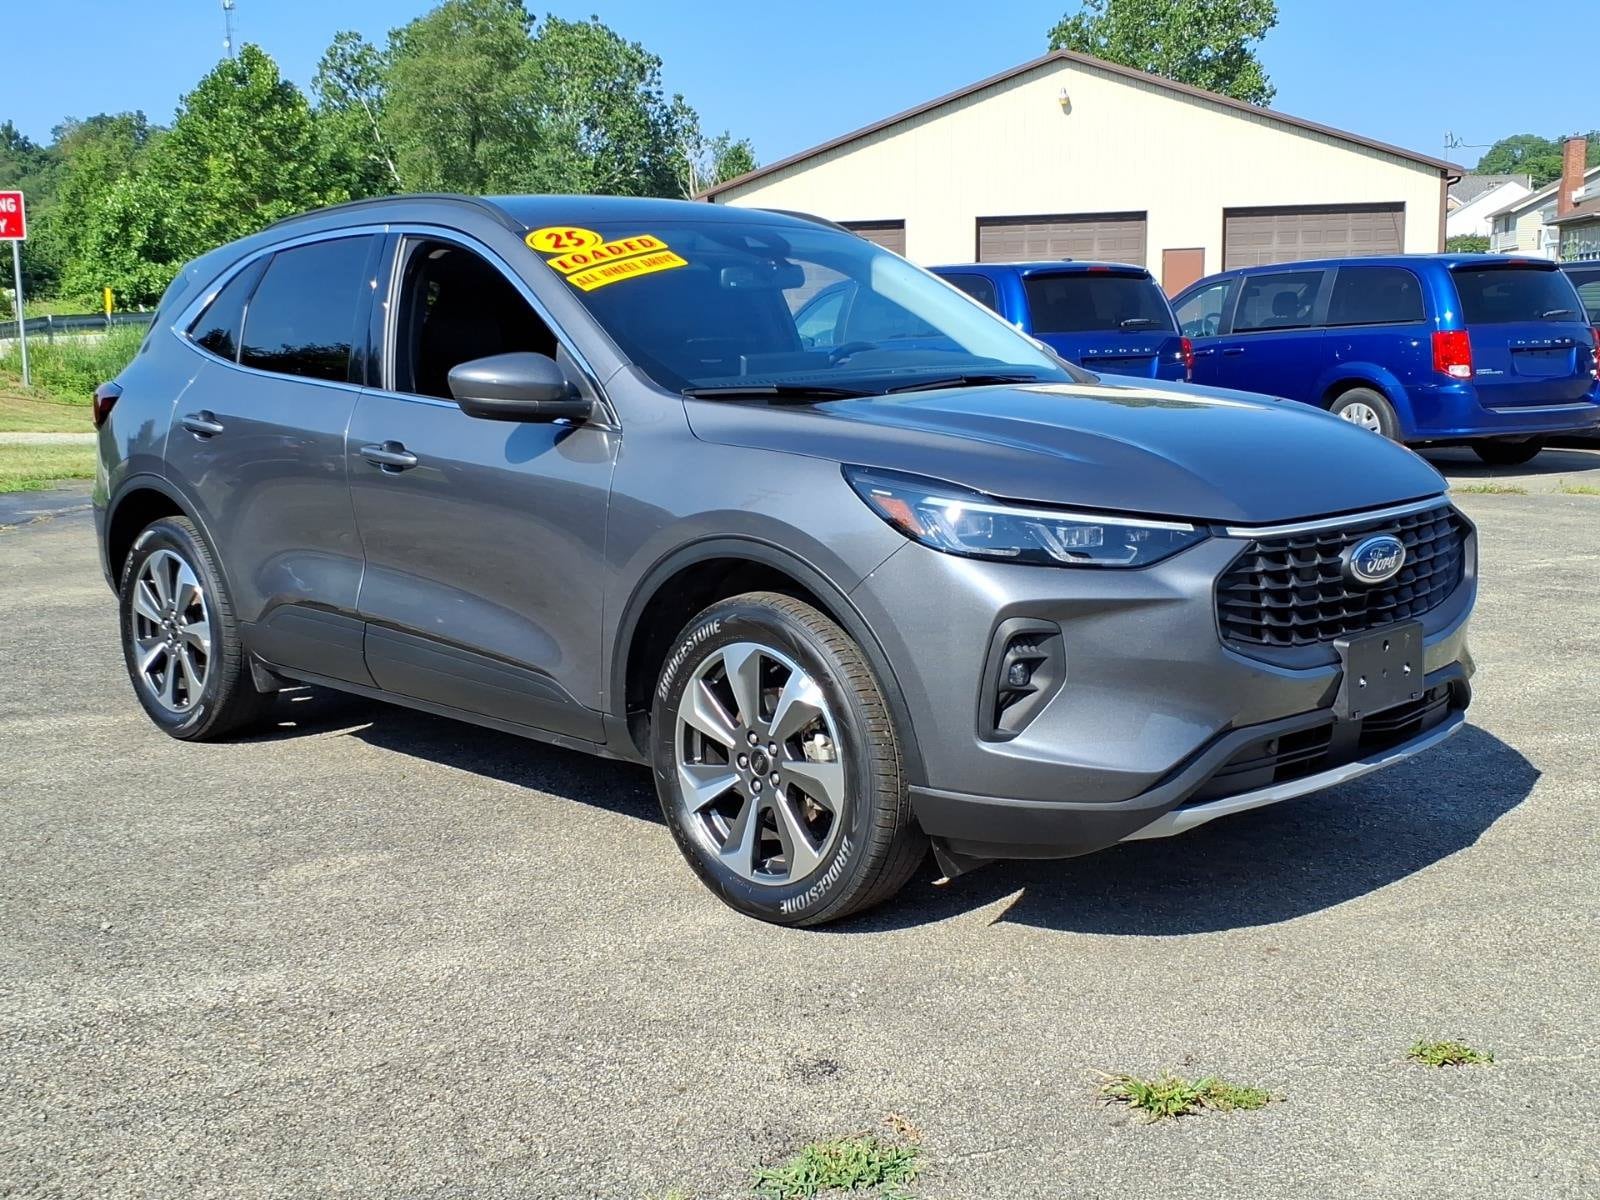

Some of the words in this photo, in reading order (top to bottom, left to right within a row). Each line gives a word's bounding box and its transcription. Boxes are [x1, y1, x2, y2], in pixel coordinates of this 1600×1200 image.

[544, 230, 586, 249] 25
[556, 238, 657, 269] LOADED
[575, 272, 602, 286] ALL
[600, 261, 643, 277] WHEEL
[640, 254, 678, 267] DRIVE
[1366, 546, 1400, 573] Ford
[658, 618, 722, 702] BRIDGESTONE
[780, 834, 855, 915] BRIDGESTONE
